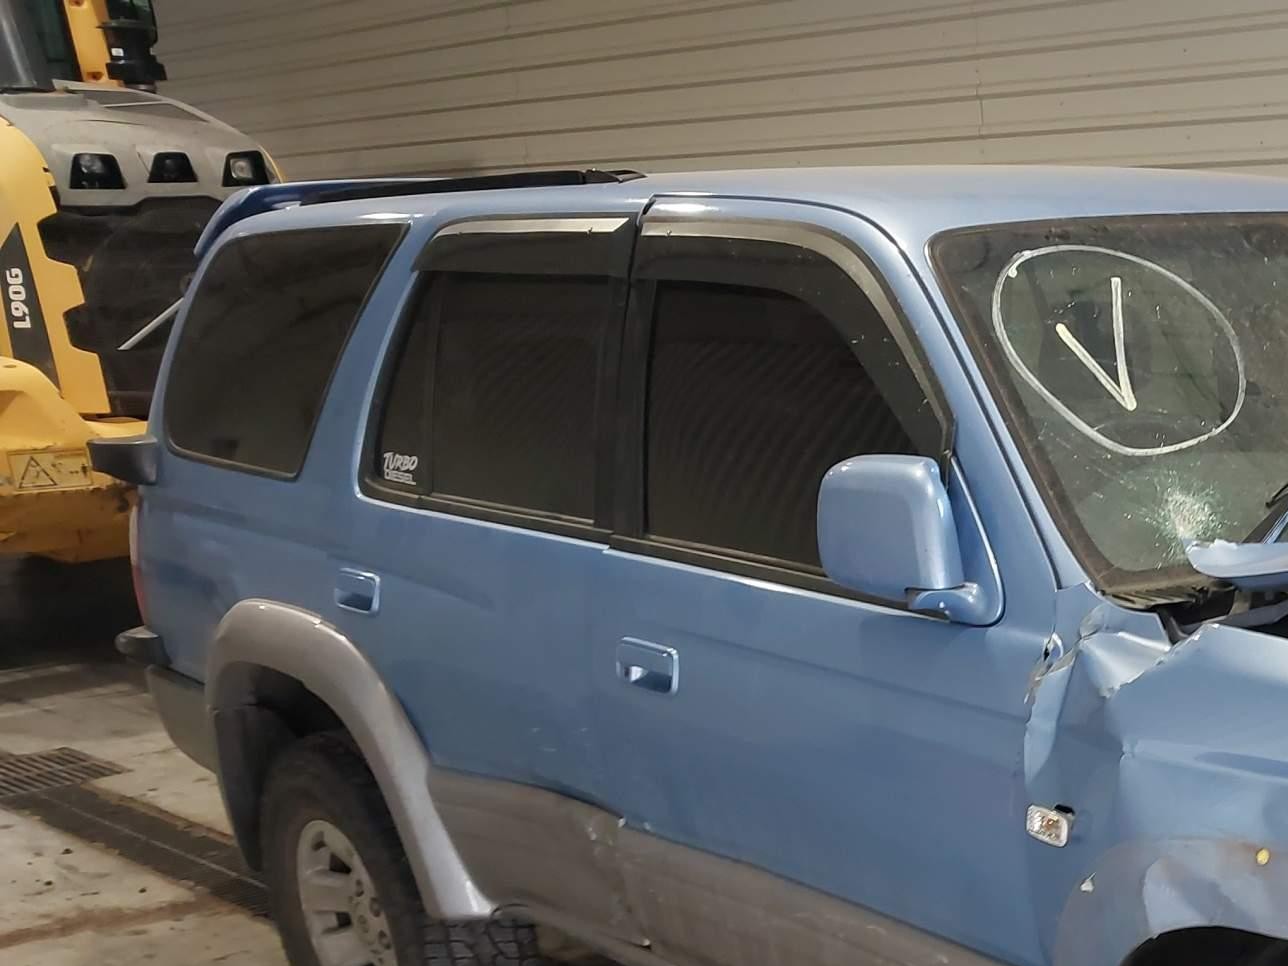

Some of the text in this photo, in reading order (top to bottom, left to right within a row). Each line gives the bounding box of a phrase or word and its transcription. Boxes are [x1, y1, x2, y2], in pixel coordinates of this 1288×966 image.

[6, 267, 31, 328] L90G
[1055, 277, 1137, 411] V
[383, 452, 418, 471] TURBO
